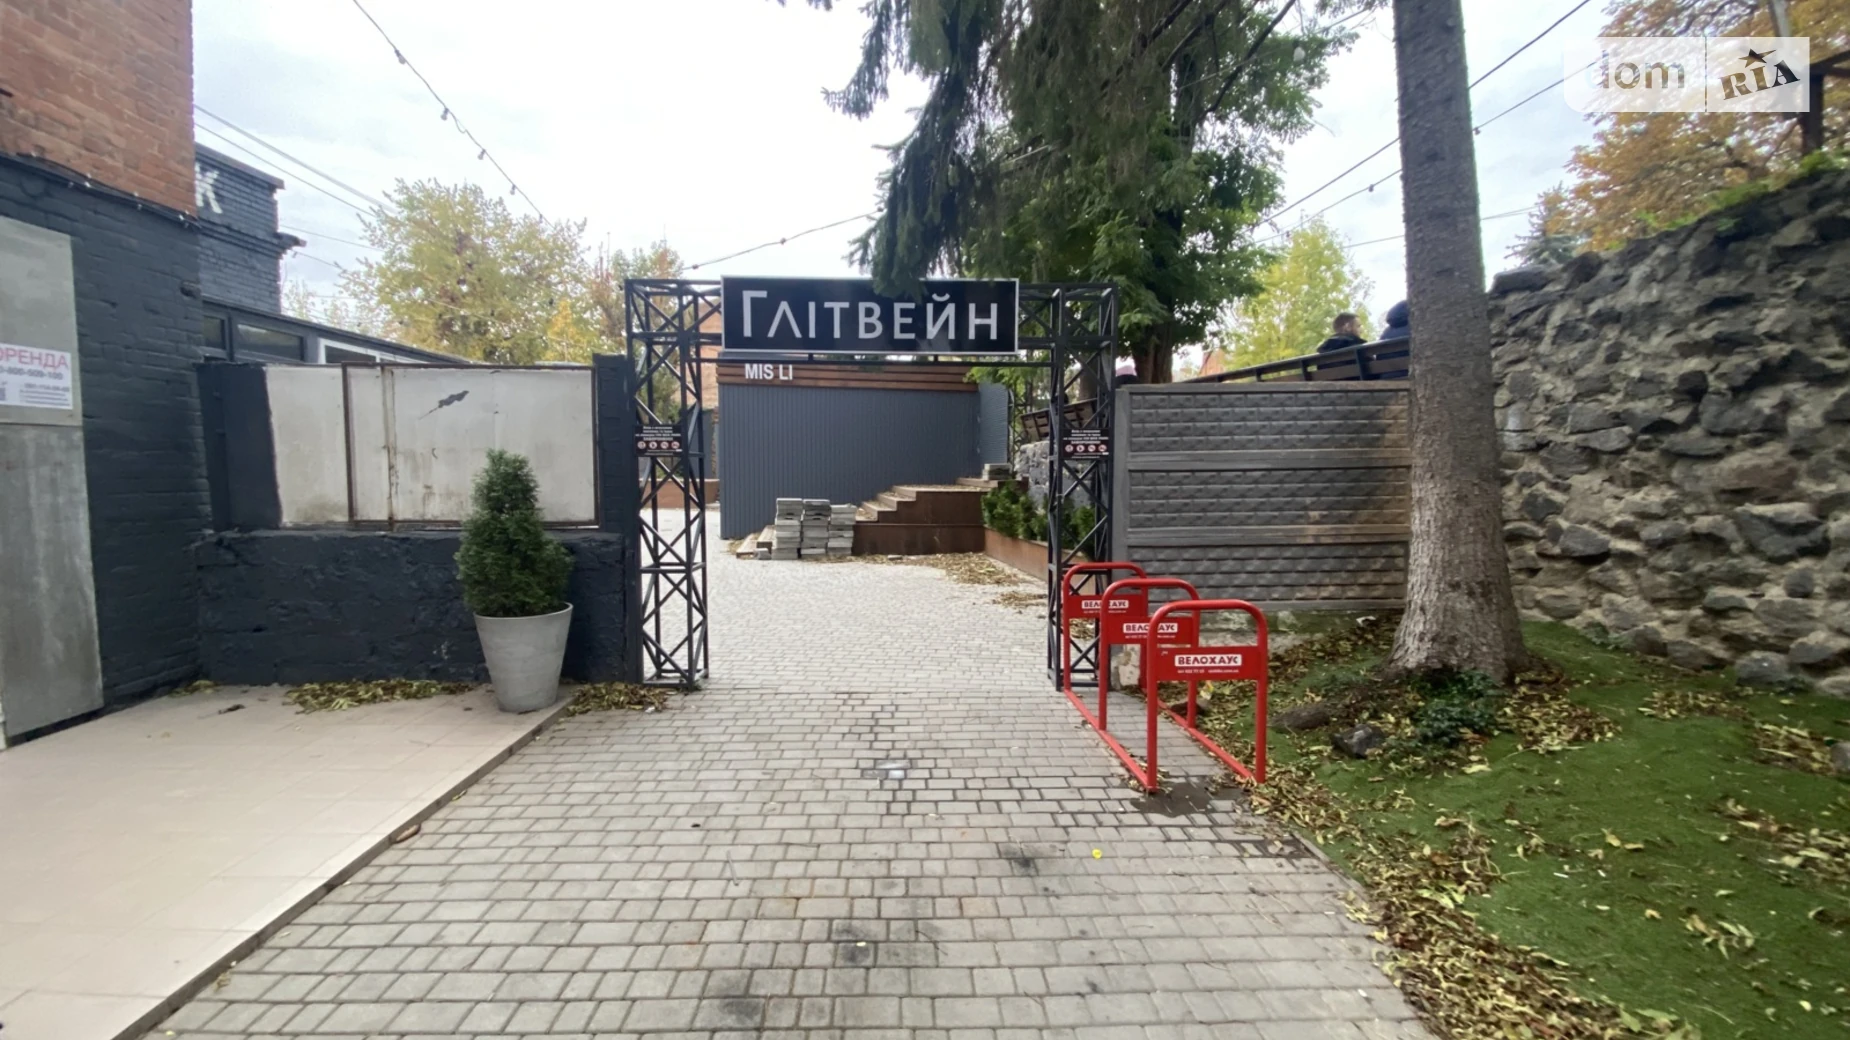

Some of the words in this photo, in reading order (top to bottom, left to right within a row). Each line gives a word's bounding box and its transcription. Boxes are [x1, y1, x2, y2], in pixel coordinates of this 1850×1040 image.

[742, 290, 998, 340] ГЛІТВЕЙН
[745, 363, 774, 380] MIS
[779, 364, 793, 381] LI
[1084, 600, 1126, 608] ВЕЛАУС
[1126, 624, 1175, 632] ВЕЛОАУС
[1178, 656, 1238, 665] ВЕЛОХАУС
